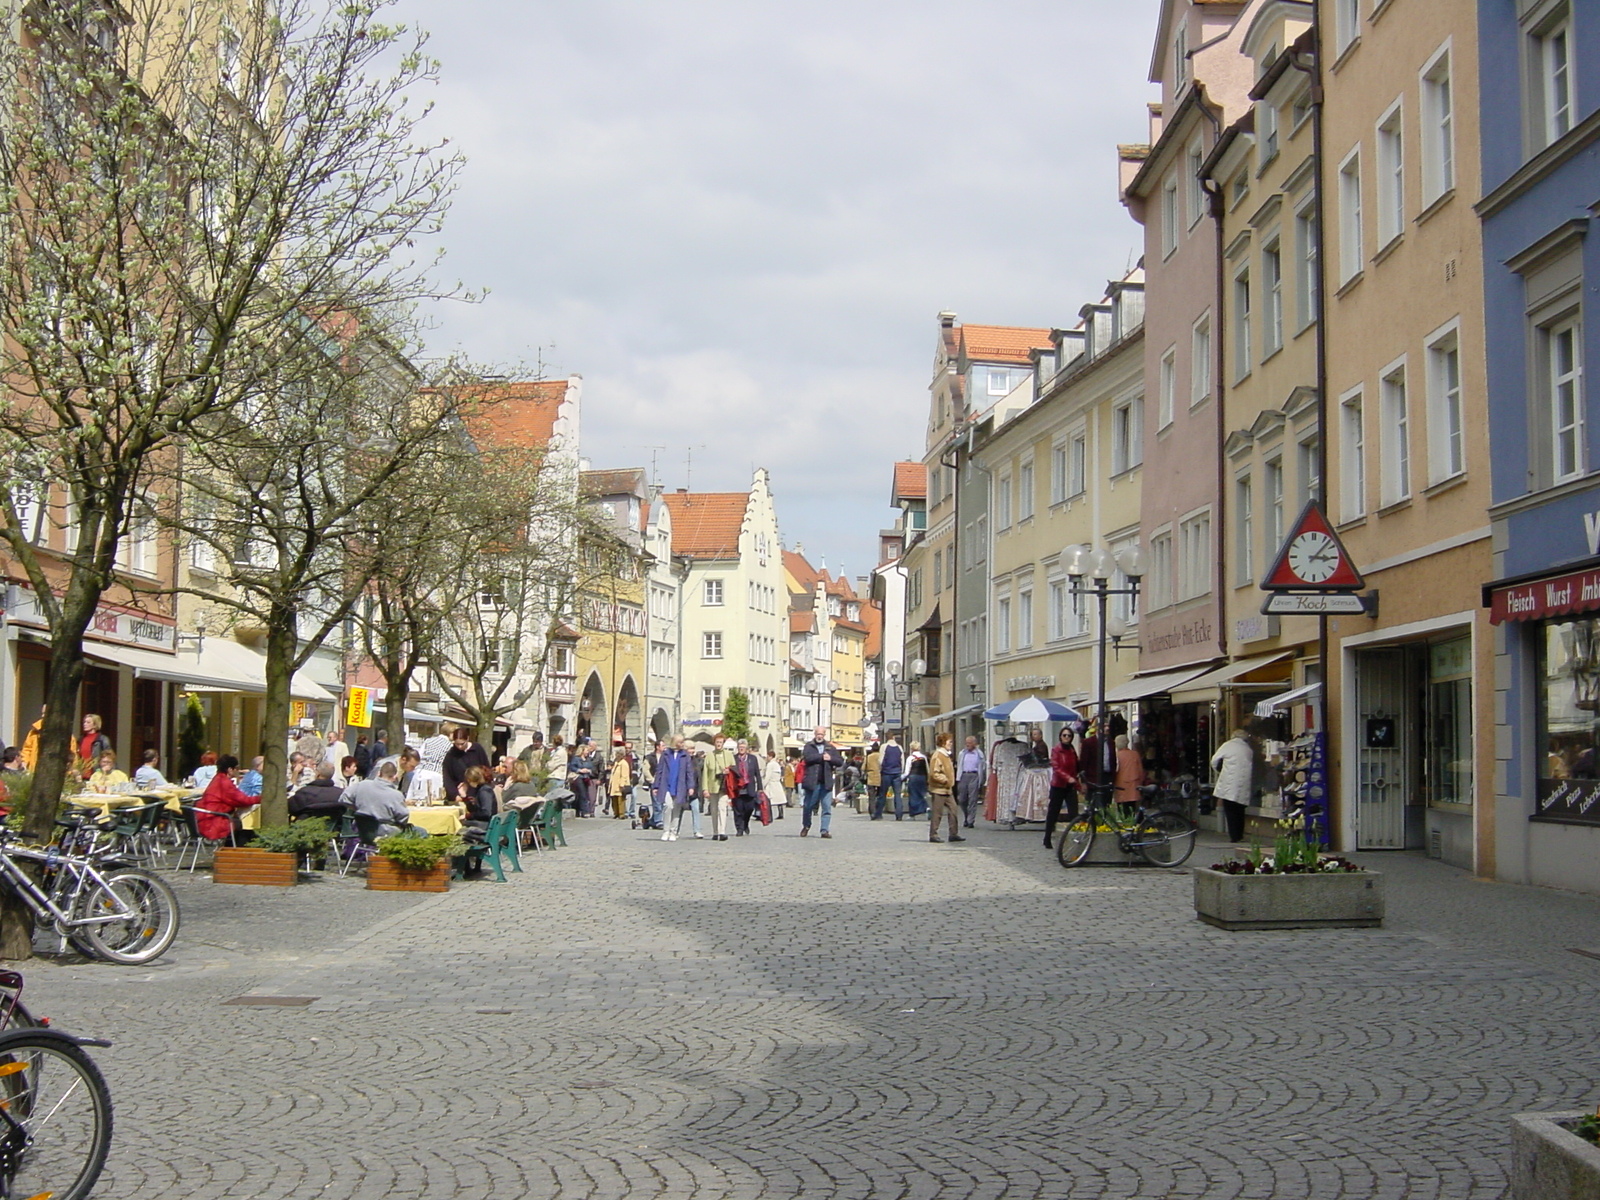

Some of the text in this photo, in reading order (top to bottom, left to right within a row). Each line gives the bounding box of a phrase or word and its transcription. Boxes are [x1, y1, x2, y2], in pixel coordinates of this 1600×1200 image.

[1296, 596, 1327, 611] Koch
[1507, 588, 1535, 614] Fleisch
[1546, 582, 1571, 608] Wurst
[351, 691, 363, 724] Kodak
[1541, 780, 1568, 810] Sandwich
[1566, 786, 1581, 808] Pizza
